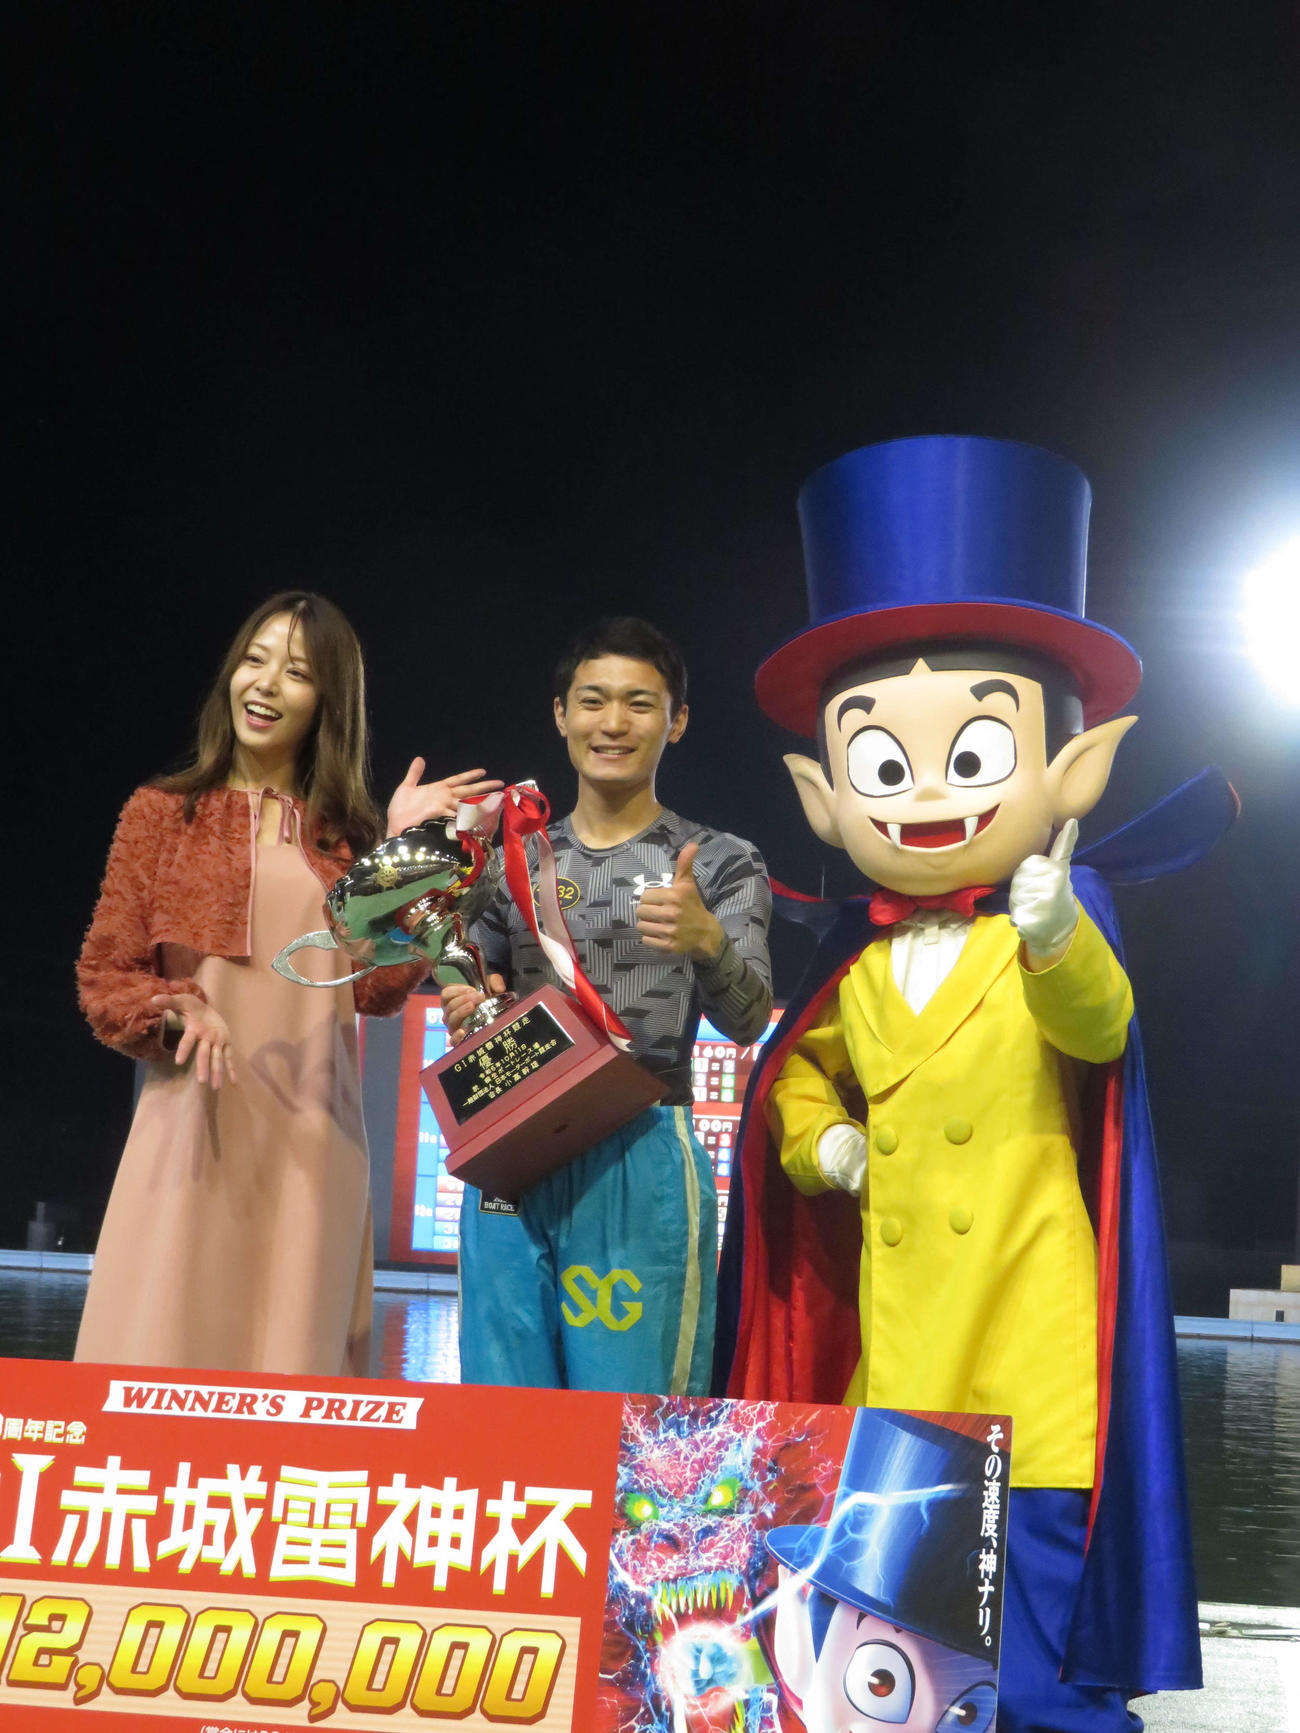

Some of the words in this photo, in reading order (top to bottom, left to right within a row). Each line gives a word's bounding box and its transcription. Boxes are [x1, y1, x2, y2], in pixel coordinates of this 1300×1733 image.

[560, 1265, 643, 1331] SG
[121, 1385, 285, 1417] WINNER'S
[299, 1395, 408, 1424] PRIZE
[0, 1413, 87, 1445] 周年記念
